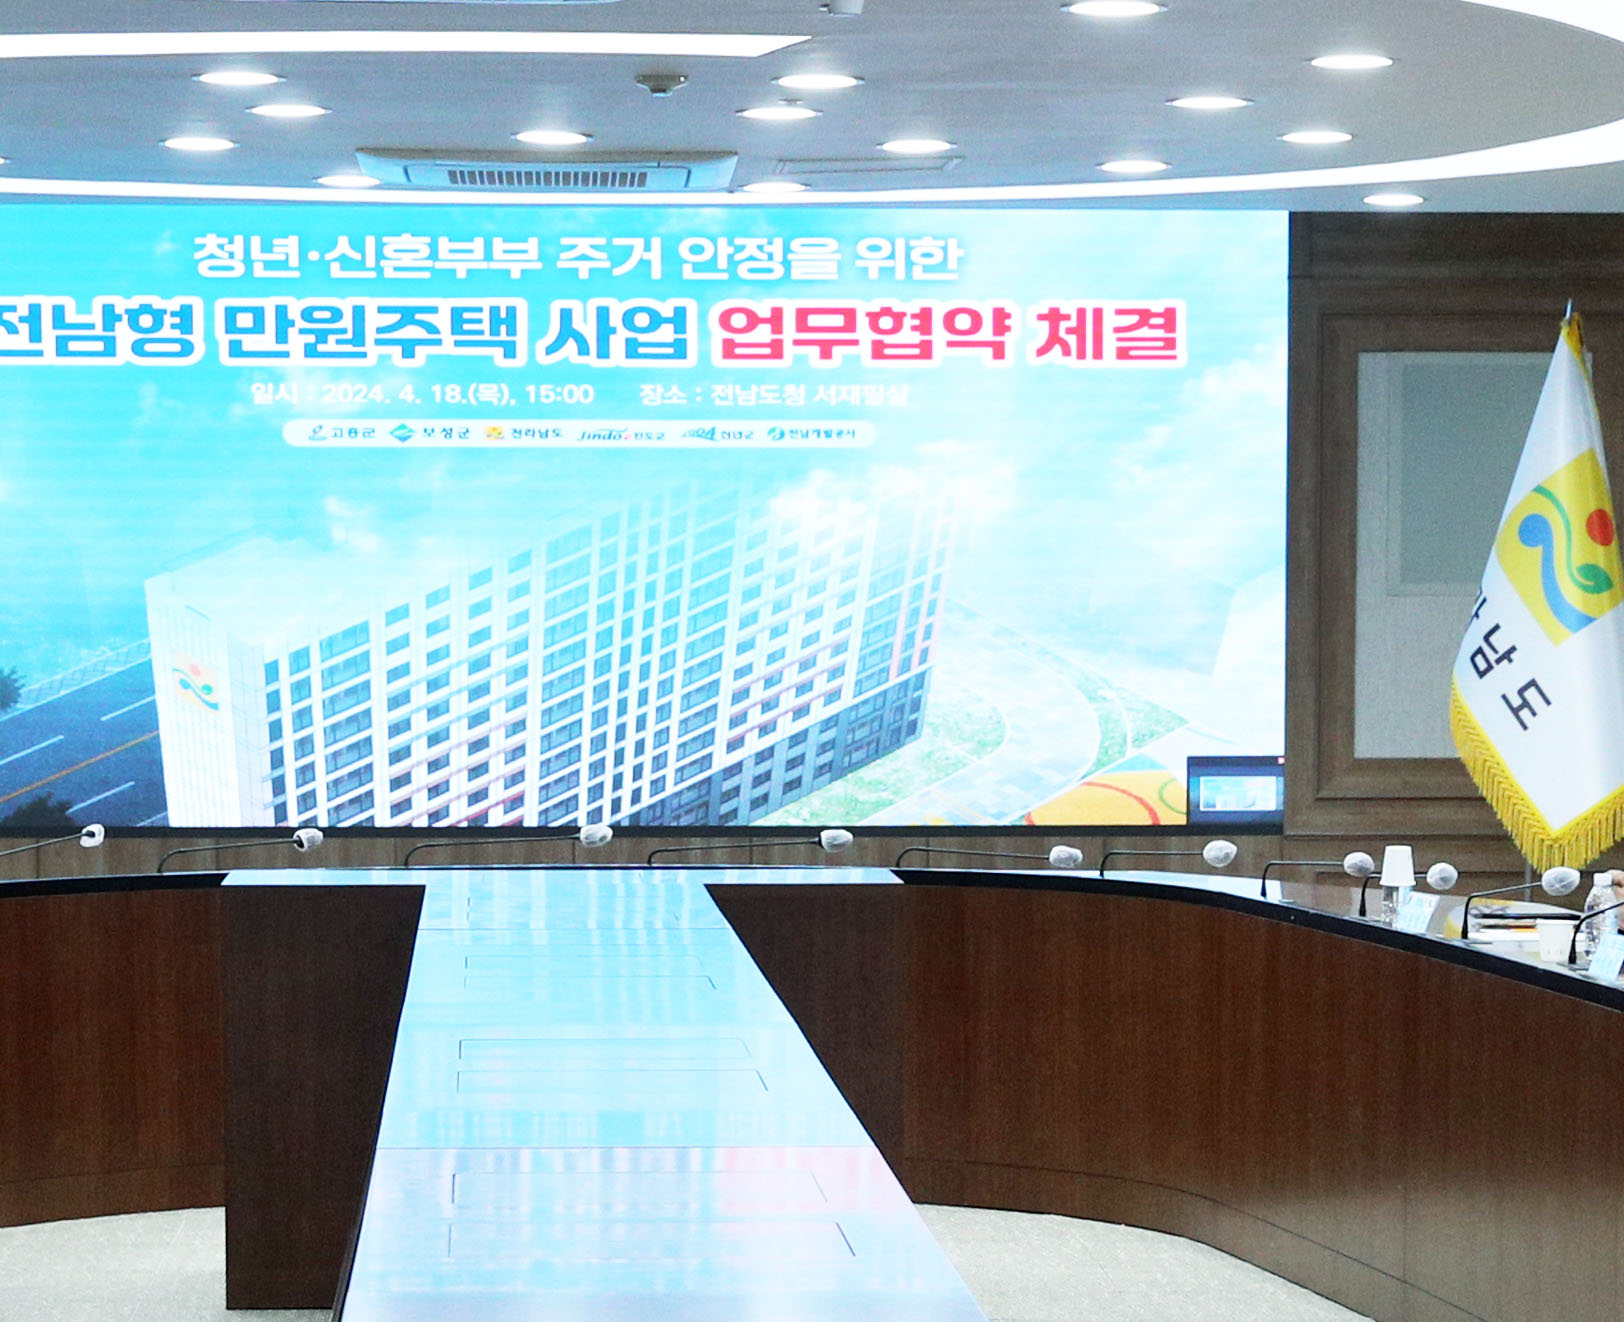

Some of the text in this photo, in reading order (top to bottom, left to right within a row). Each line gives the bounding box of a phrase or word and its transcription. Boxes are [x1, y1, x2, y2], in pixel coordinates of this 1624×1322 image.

[193, 233, 968, 281] 청년·신혼부부 주거 안정을 위한
[220, 301, 520, 361] 만원주택
[543, 303, 691, 362] 사업
[715, 303, 1016, 363] 업무협약
[1033, 303, 1181, 363] 체결
[251, 384, 301, 406] 일시
[323, 383, 393, 406] 2024.
[397, 384, 424, 405] 4.
[526, 384, 594, 405] 15:00
[639, 383, 687, 406] 장소
[710, 383, 806, 406] 전남도청
[813, 383, 909, 407] 서재필실
[422, 426, 471, 440] 보성군
[511, 427, 564, 440] 전라남도
[577, 428, 628, 442] Jindo
